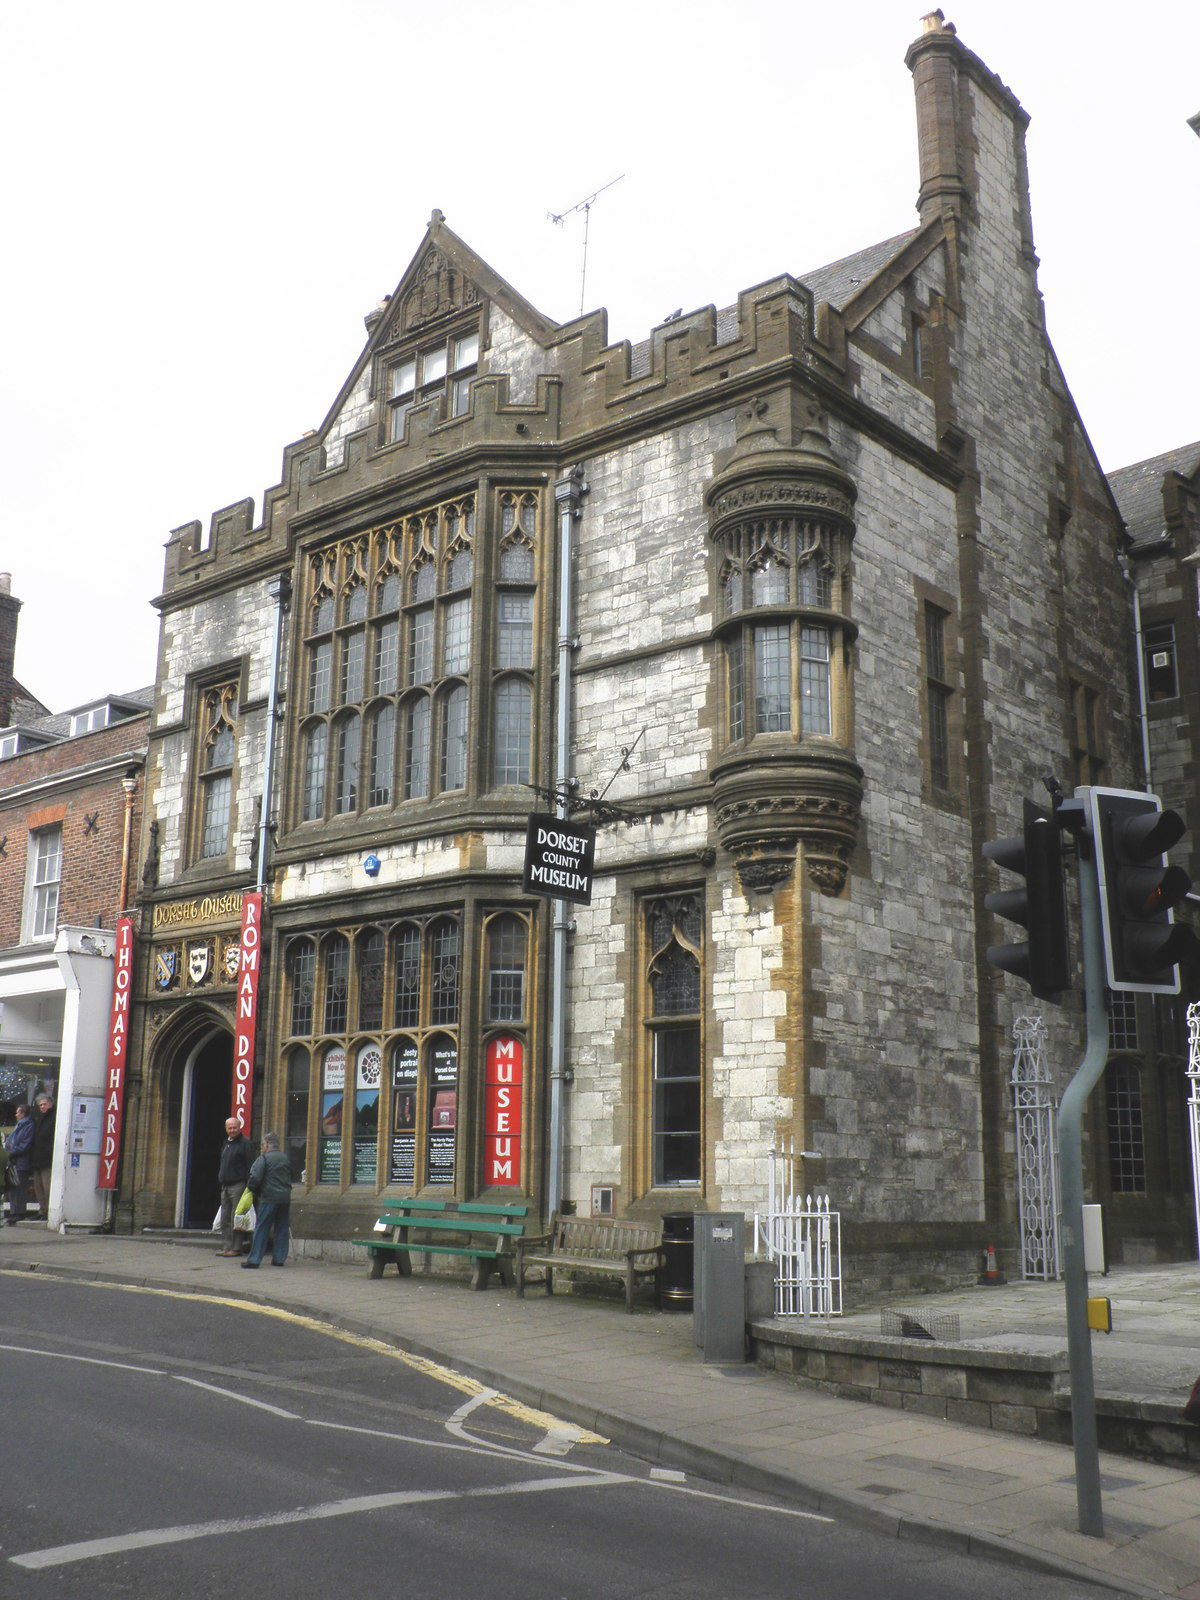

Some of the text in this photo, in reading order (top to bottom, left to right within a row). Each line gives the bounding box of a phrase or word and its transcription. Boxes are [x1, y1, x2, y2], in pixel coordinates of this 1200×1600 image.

[537, 828, 588, 855] DORSET
[542, 851, 580, 869] COUNTY
[531, 864, 588, 892] MUSEUM
[236, 903, 257, 1130] ROMAN DORS
[104, 925, 129, 1180] THOMAS HARDY
[400, 1059, 418, 1068] portrai
[404, 1070, 418, 1078] displ
[493, 1040, 514, 1179] MUSEUM
